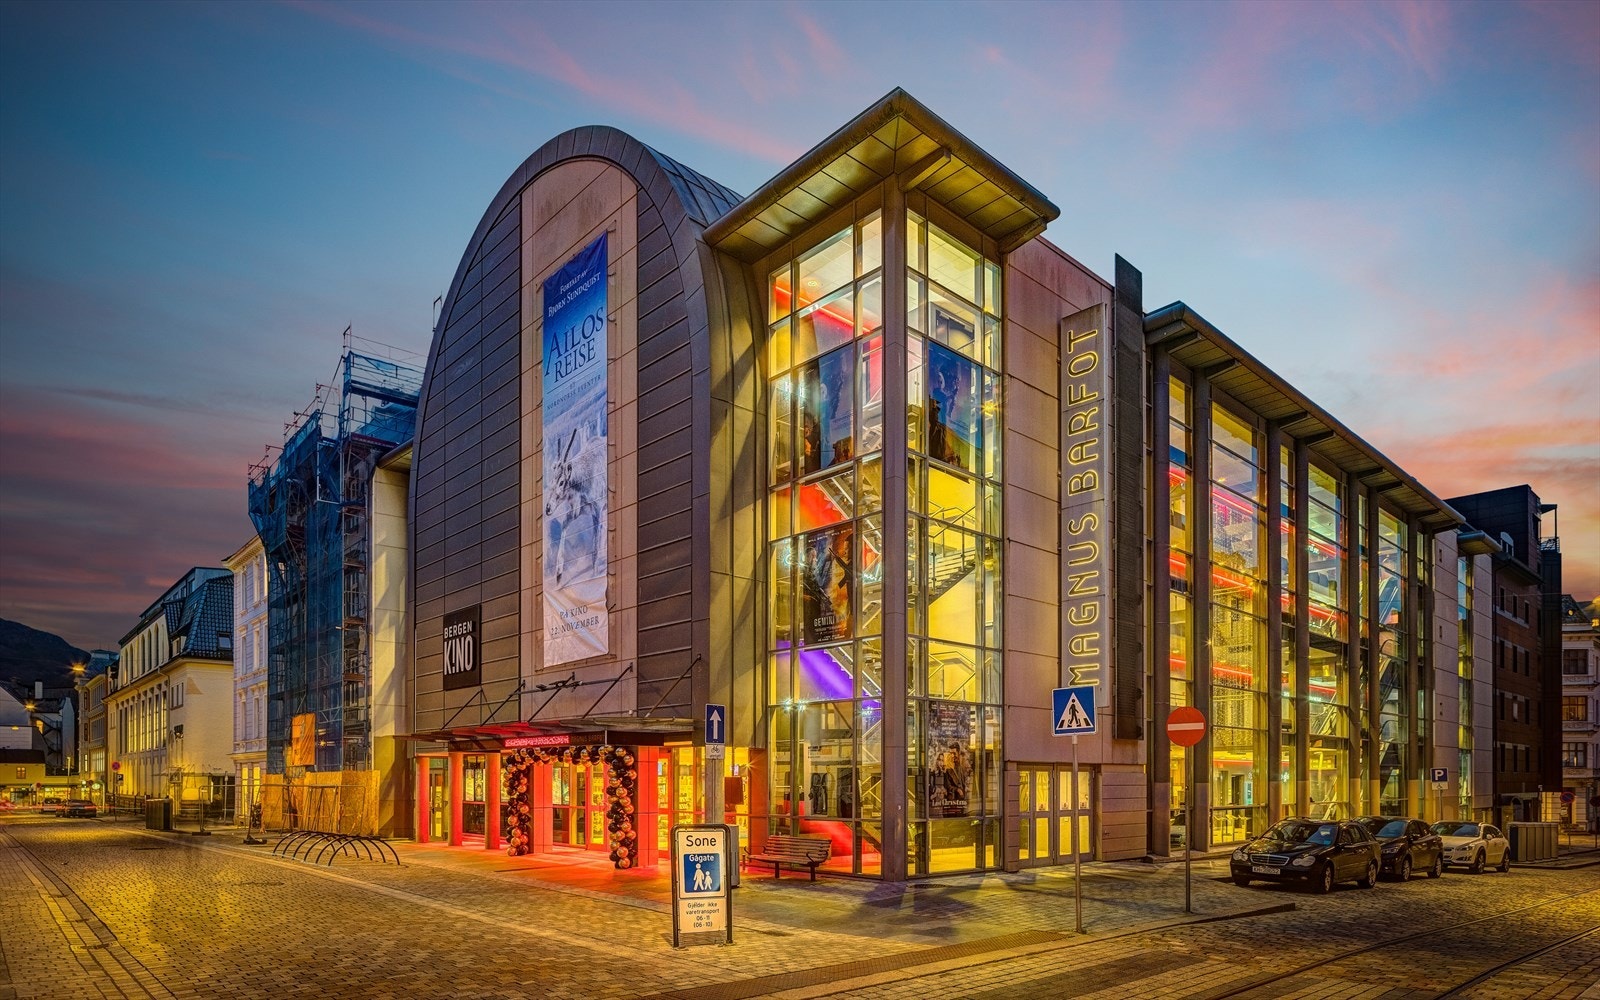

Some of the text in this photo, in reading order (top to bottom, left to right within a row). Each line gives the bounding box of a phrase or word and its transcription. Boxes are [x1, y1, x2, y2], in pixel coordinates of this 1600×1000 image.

[566, 271, 601, 303] SUNDQUIST
[544, 306, 604, 377] AILOS
[554, 337, 597, 383] REISE
[1067, 328, 1100, 687] MAGNUS BARFOT
[570, 604, 588, 617] KINO
[444, 620, 473, 639] BERGEN
[561, 615, 600, 633] NOVEMBER
[813, 615, 835, 627] GEMINI
[1434, 769, 1445, 781] P
[685, 834, 717, 847] Sone
[688, 854, 715, 863] Gågate
